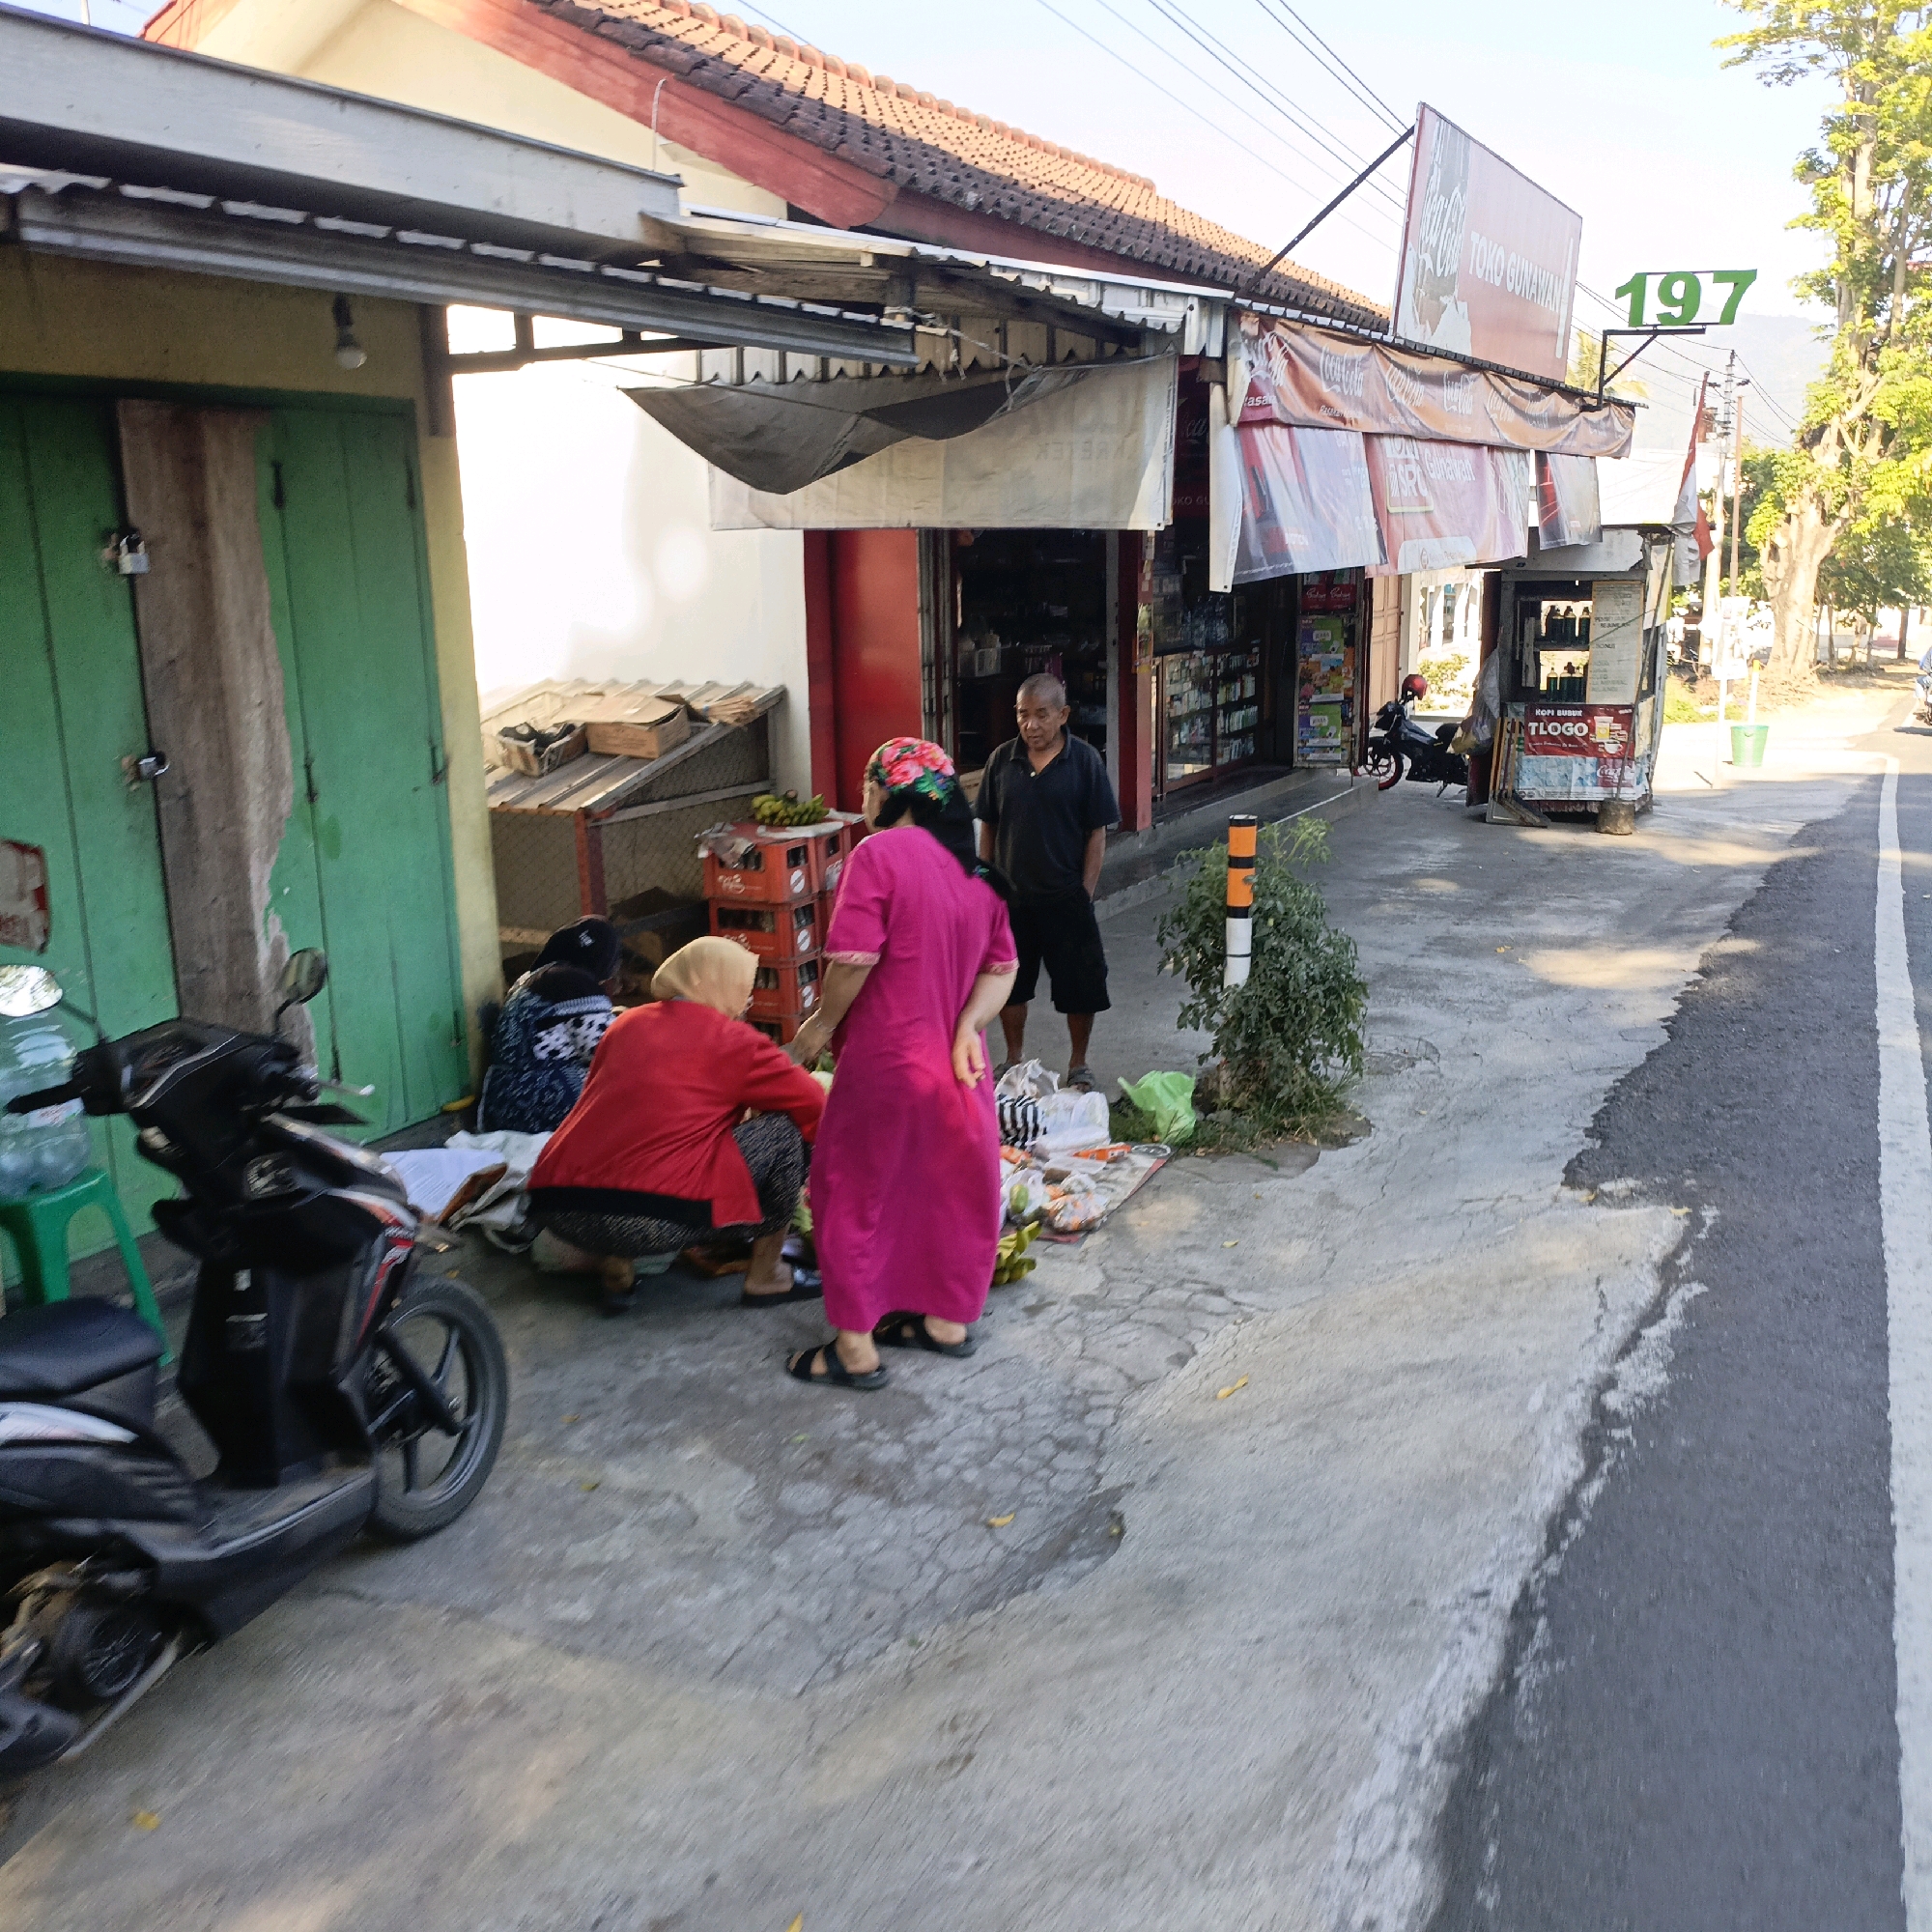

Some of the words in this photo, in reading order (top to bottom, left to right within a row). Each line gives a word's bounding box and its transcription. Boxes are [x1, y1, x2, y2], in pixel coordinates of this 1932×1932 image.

[1469, 230, 1505, 286] TOKO
[1506, 251, 1562, 313] GUNAWAN
[1615, 269, 1757, 327] 197
[1424, 448, 1475, 481] Gunawan
[1528, 722, 1588, 737] TLOGO
